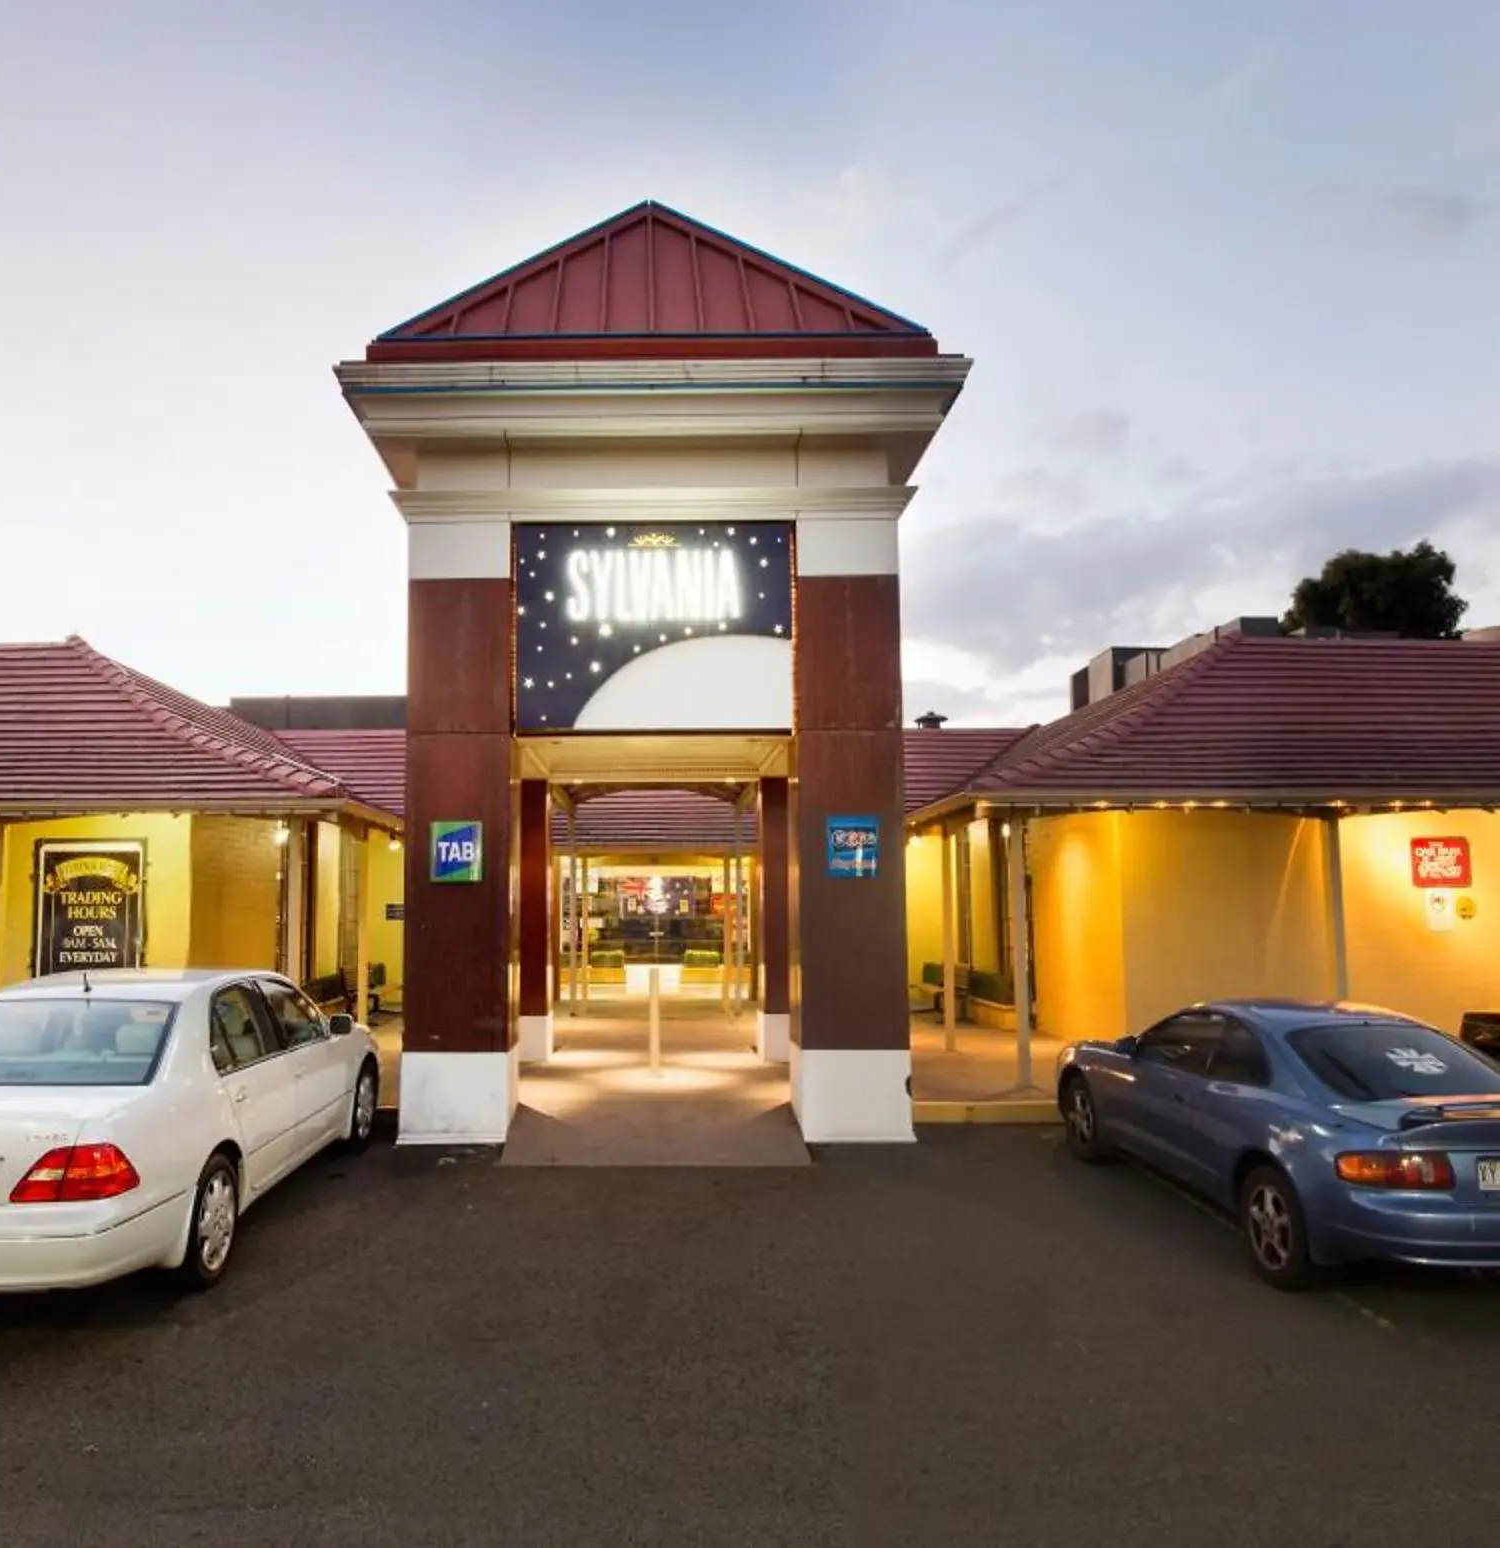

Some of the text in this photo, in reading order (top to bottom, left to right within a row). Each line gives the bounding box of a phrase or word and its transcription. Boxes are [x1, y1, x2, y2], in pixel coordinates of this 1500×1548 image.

[566, 549, 742, 622] SYLVANIA
[437, 841, 474, 862] TAB
[60, 891, 123, 905] TRADING
[67, 905, 117, 919] HOURS
[73, 925, 103, 936] OPEN
[59, 951, 118, 963] EVERYDAY
